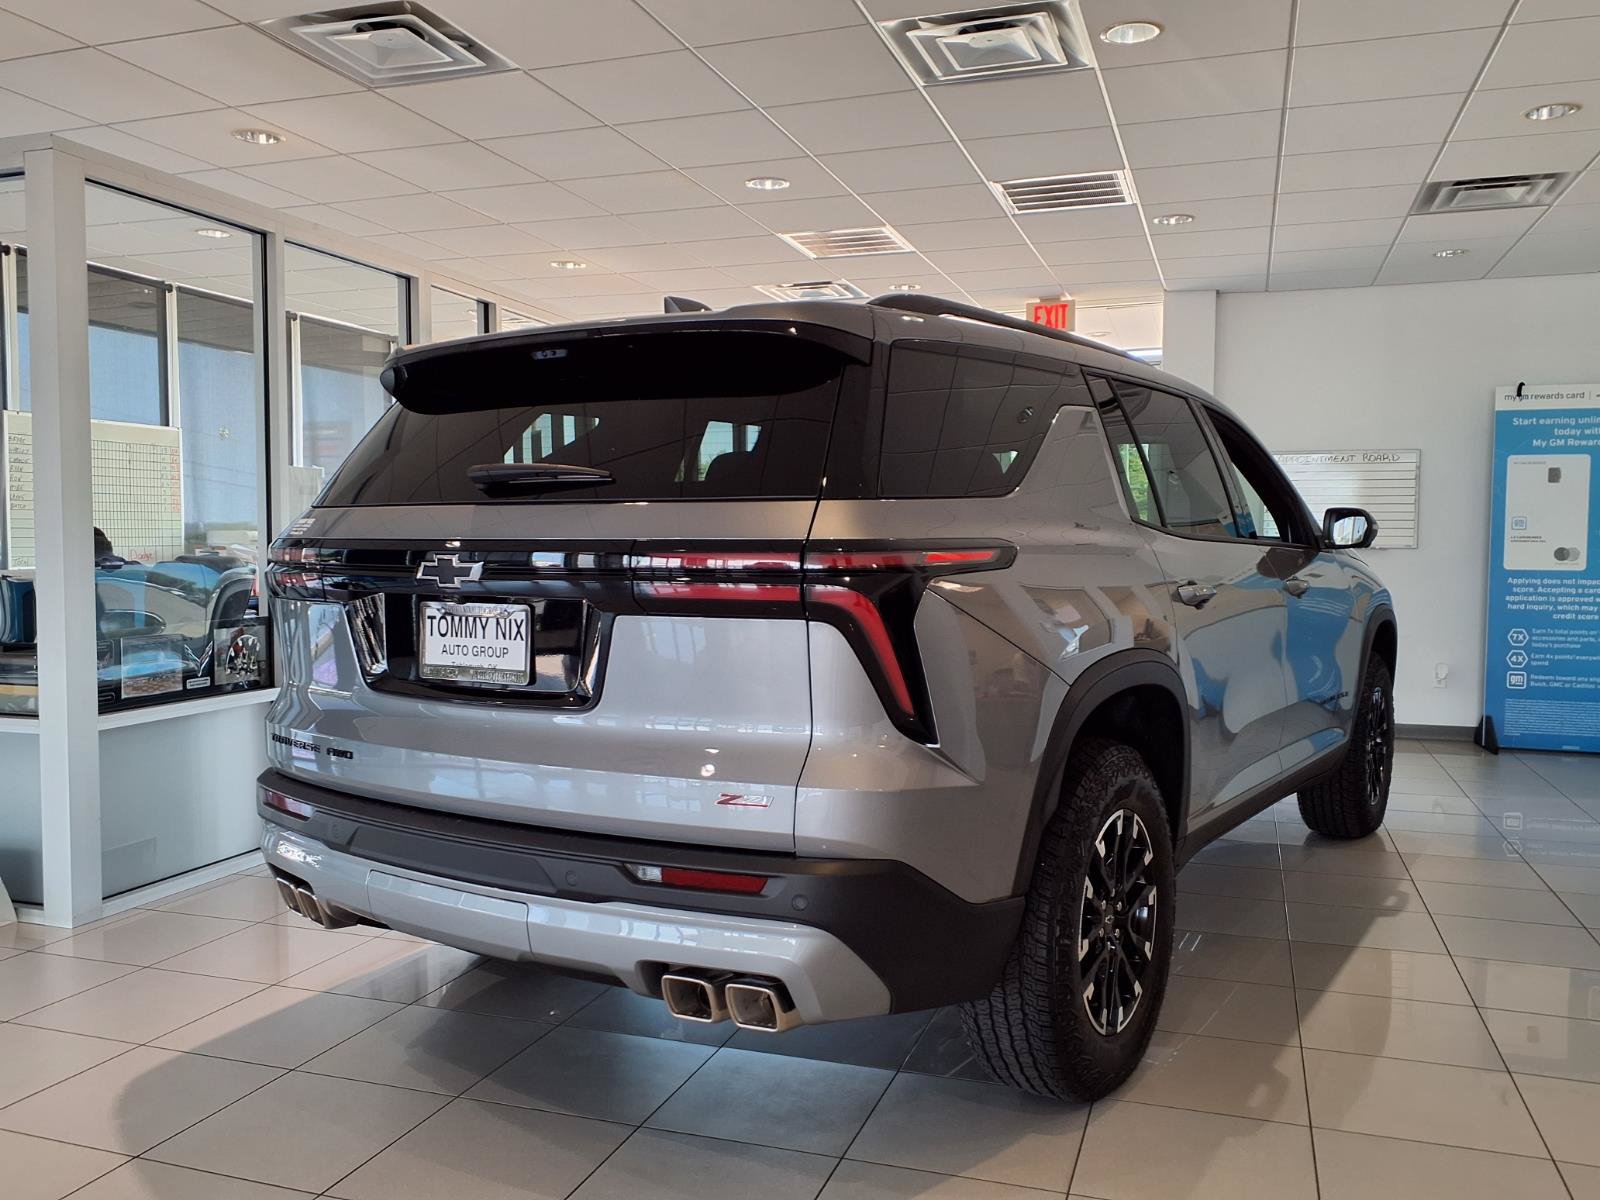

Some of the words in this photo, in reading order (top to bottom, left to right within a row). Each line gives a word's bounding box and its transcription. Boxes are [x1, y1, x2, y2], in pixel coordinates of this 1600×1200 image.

[1033, 303, 1068, 329] EXIT
[1530, 392, 1564, 400] rewards
[1566, 391, 1585, 400] card
[1512, 417, 1537, 426] Start
[1539, 416, 1576, 426] earning
[1554, 428, 1581, 436] today
[1532, 440, 1547, 448] My
[1507, 577, 1541, 585] Applying
[1537, 587, 1576, 595] Accepting
[427, 615, 489, 639] TOMMY
[496, 618, 524, 641] NIX
[1512, 633, 1524, 641] 7X
[441, 644, 469, 656] AUTO
[472, 645, 509, 659] GROUP
